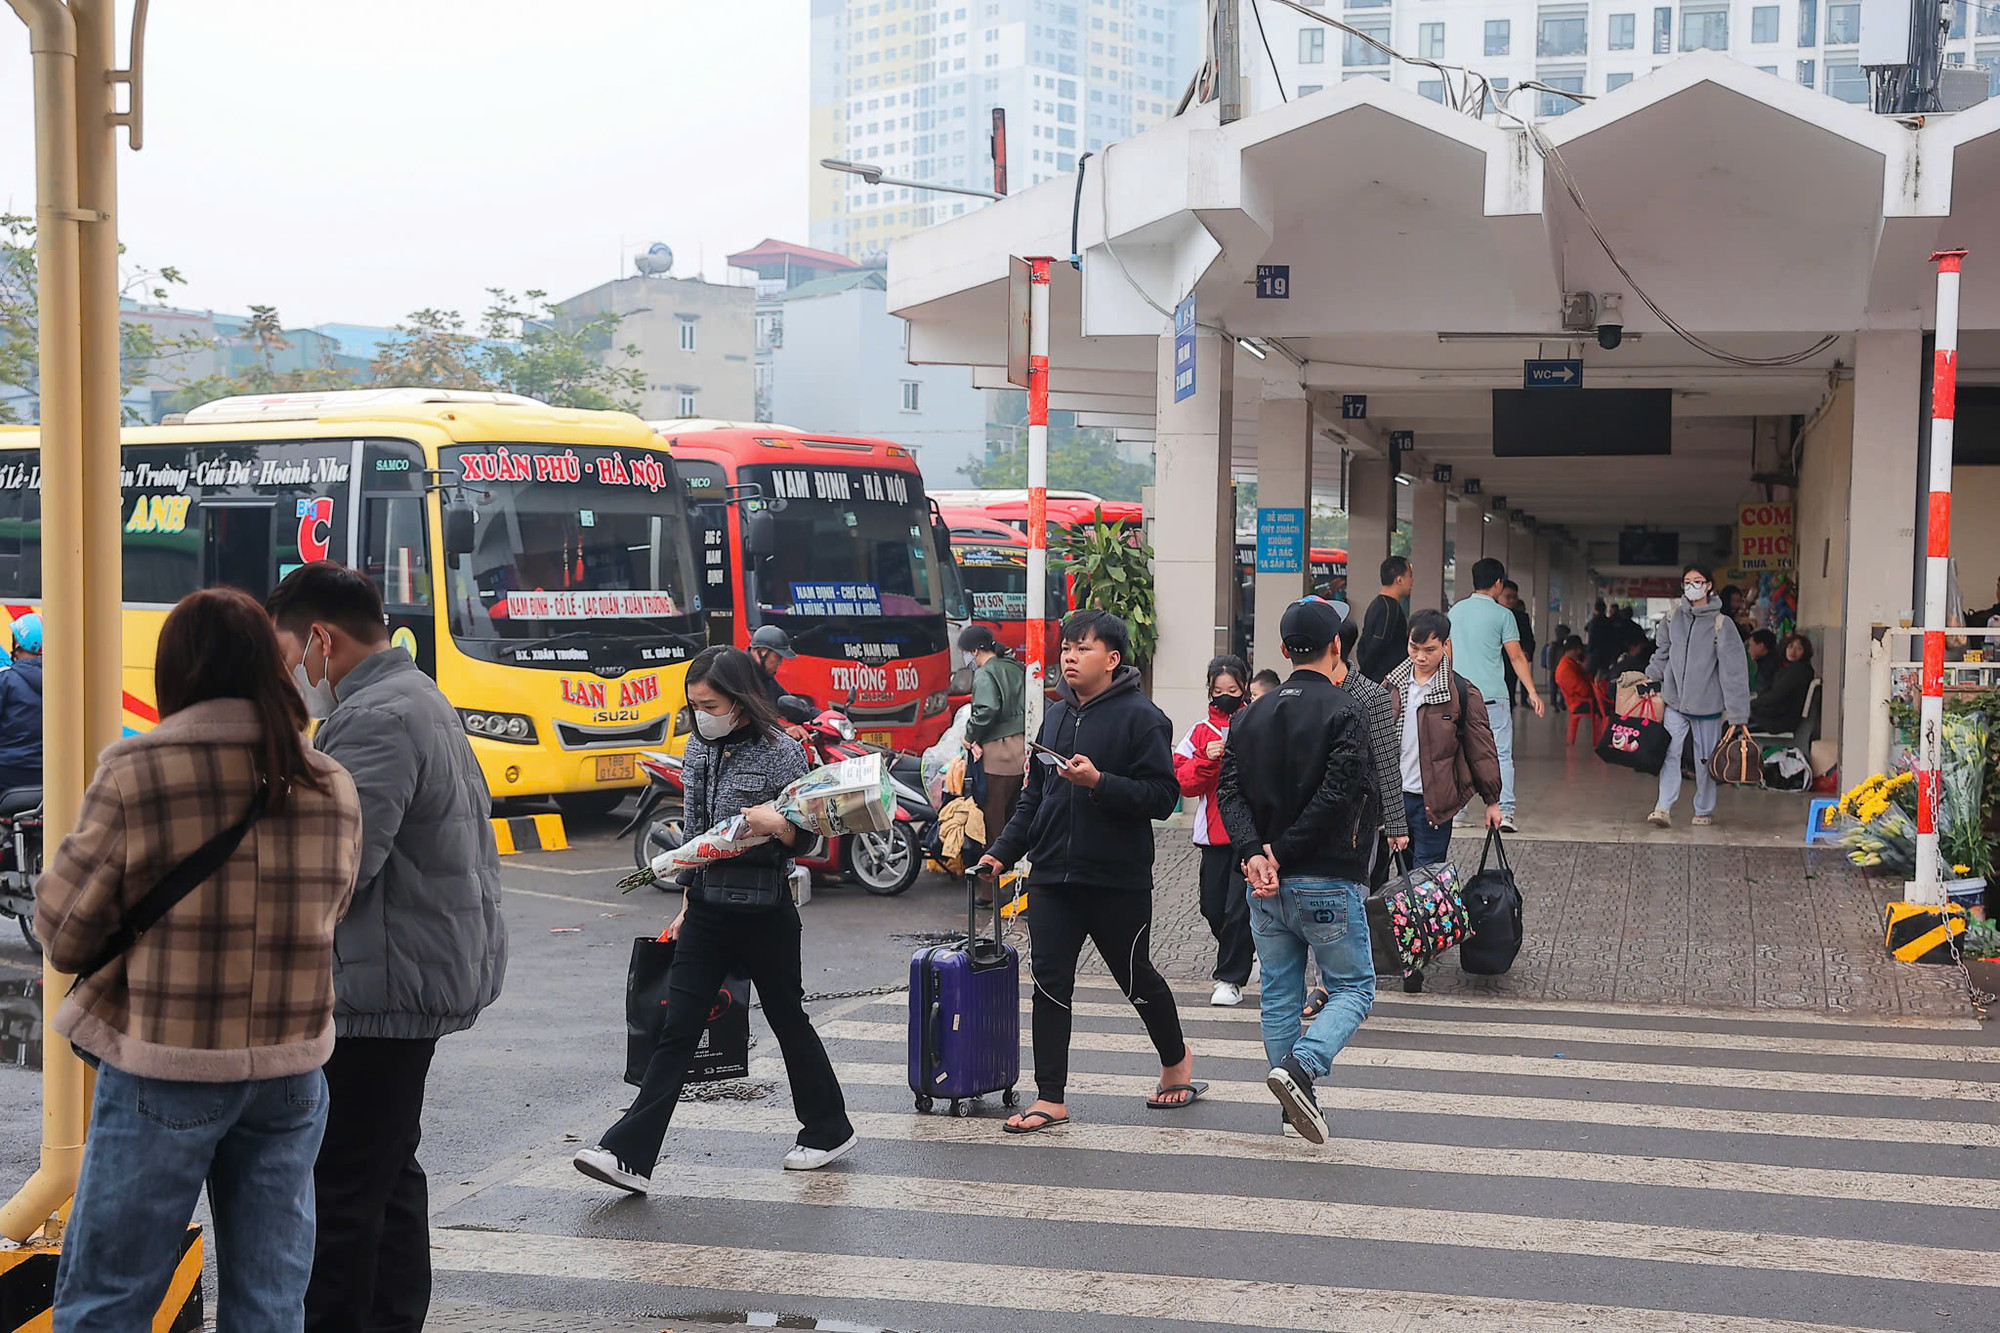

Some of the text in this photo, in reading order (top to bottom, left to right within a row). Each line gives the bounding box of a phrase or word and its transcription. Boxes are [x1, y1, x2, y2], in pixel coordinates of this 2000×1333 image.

[1263, 278, 1286, 295] 19
[1533, 370, 1552, 379] WC
[1347, 404, 1364, 417] 17
[1398, 438, 1412, 450] 16
[224, 460, 252, 485] Đá
[258, 459, 310, 486] Hoành
[311, 457, 349, 484] Nha
[375, 459, 409, 471] SAMCO
[459, 446, 532, 482] XUÂN
[596, 451, 631, 485] HÀ
[629, 454, 667, 493] NỘI
[772, 470, 908, 506] NAM ĐỊNH HÀ NỘI
[124, 494, 191, 533] ANH
[297, 499, 318, 520] Big
[1741, 505, 1792, 526] CƠM
[298, 497, 335, 563] C
[1742, 529, 1791, 556] PHỞ
[705, 550, 722, 564] NAM
[795, 586, 816, 599] NAM
[815, 586, 836, 602] ĐỊNH
[509, 597, 529, 615] NAM
[530, 597, 549, 619] ĐỊNH
[862, 643, 881, 657] NAM
[881, 643, 900, 659] ĐỊNH
[831, 661, 918, 691] TRƯỜNG BÉO
[561, 673, 660, 709] LAN ANH
[1611, 723, 1640, 738] LOTSO
